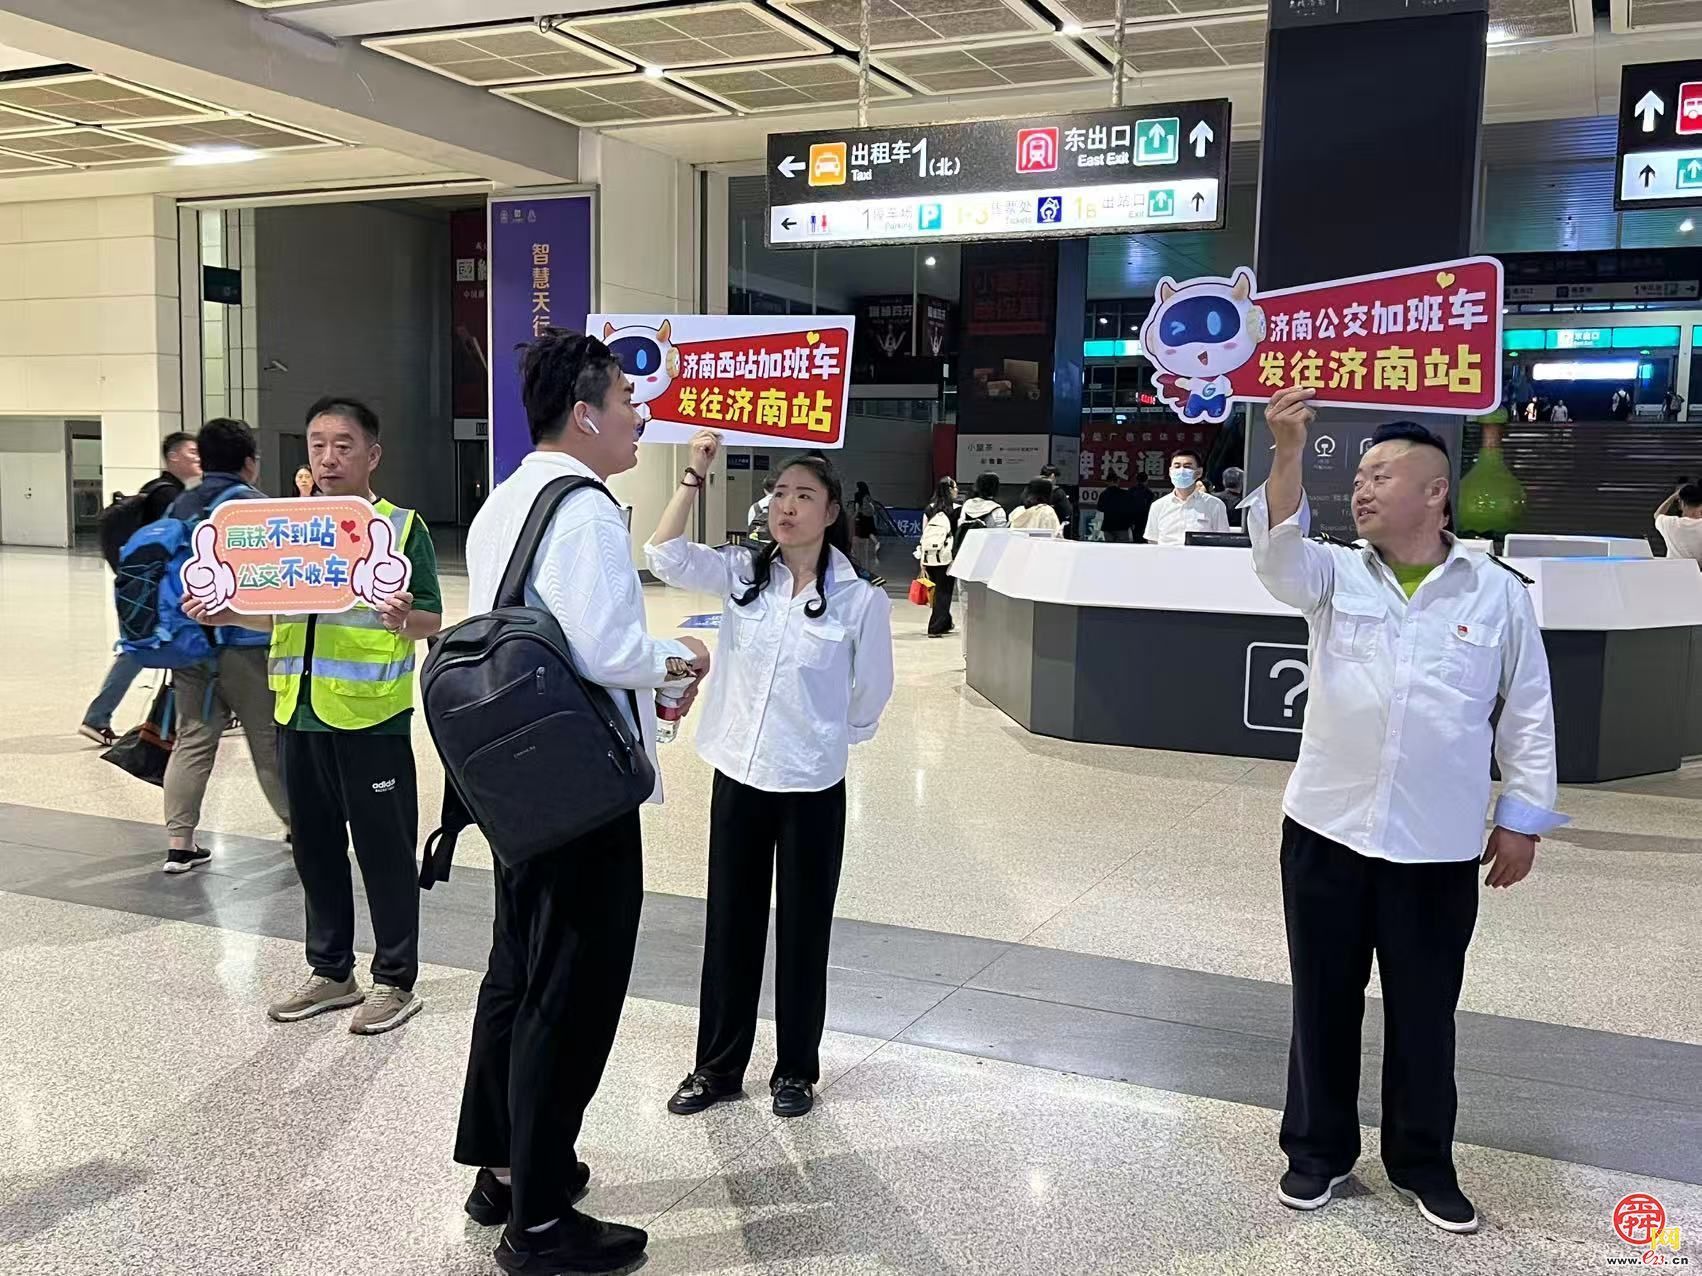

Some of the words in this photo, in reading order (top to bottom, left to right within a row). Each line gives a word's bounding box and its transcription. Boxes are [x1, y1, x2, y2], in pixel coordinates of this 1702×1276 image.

[1064, 125, 1131, 151] 东出口
[851, 169, 873, 181] Taxi
[1077, 153, 1105, 167] East
[1106, 151, 1129, 165] Exit
[1102, 193, 1145, 209] 出站口
[1269, 288, 1488, 343] 济南公交加班车
[682, 343, 840, 380] 济南西站加班车
[1258, 344, 1482, 393] 发往济南站
[677, 387, 833, 433] 发往济南站
[226, 515, 337, 549] 高铁不到站
[238, 554, 349, 588] 公交不收车
